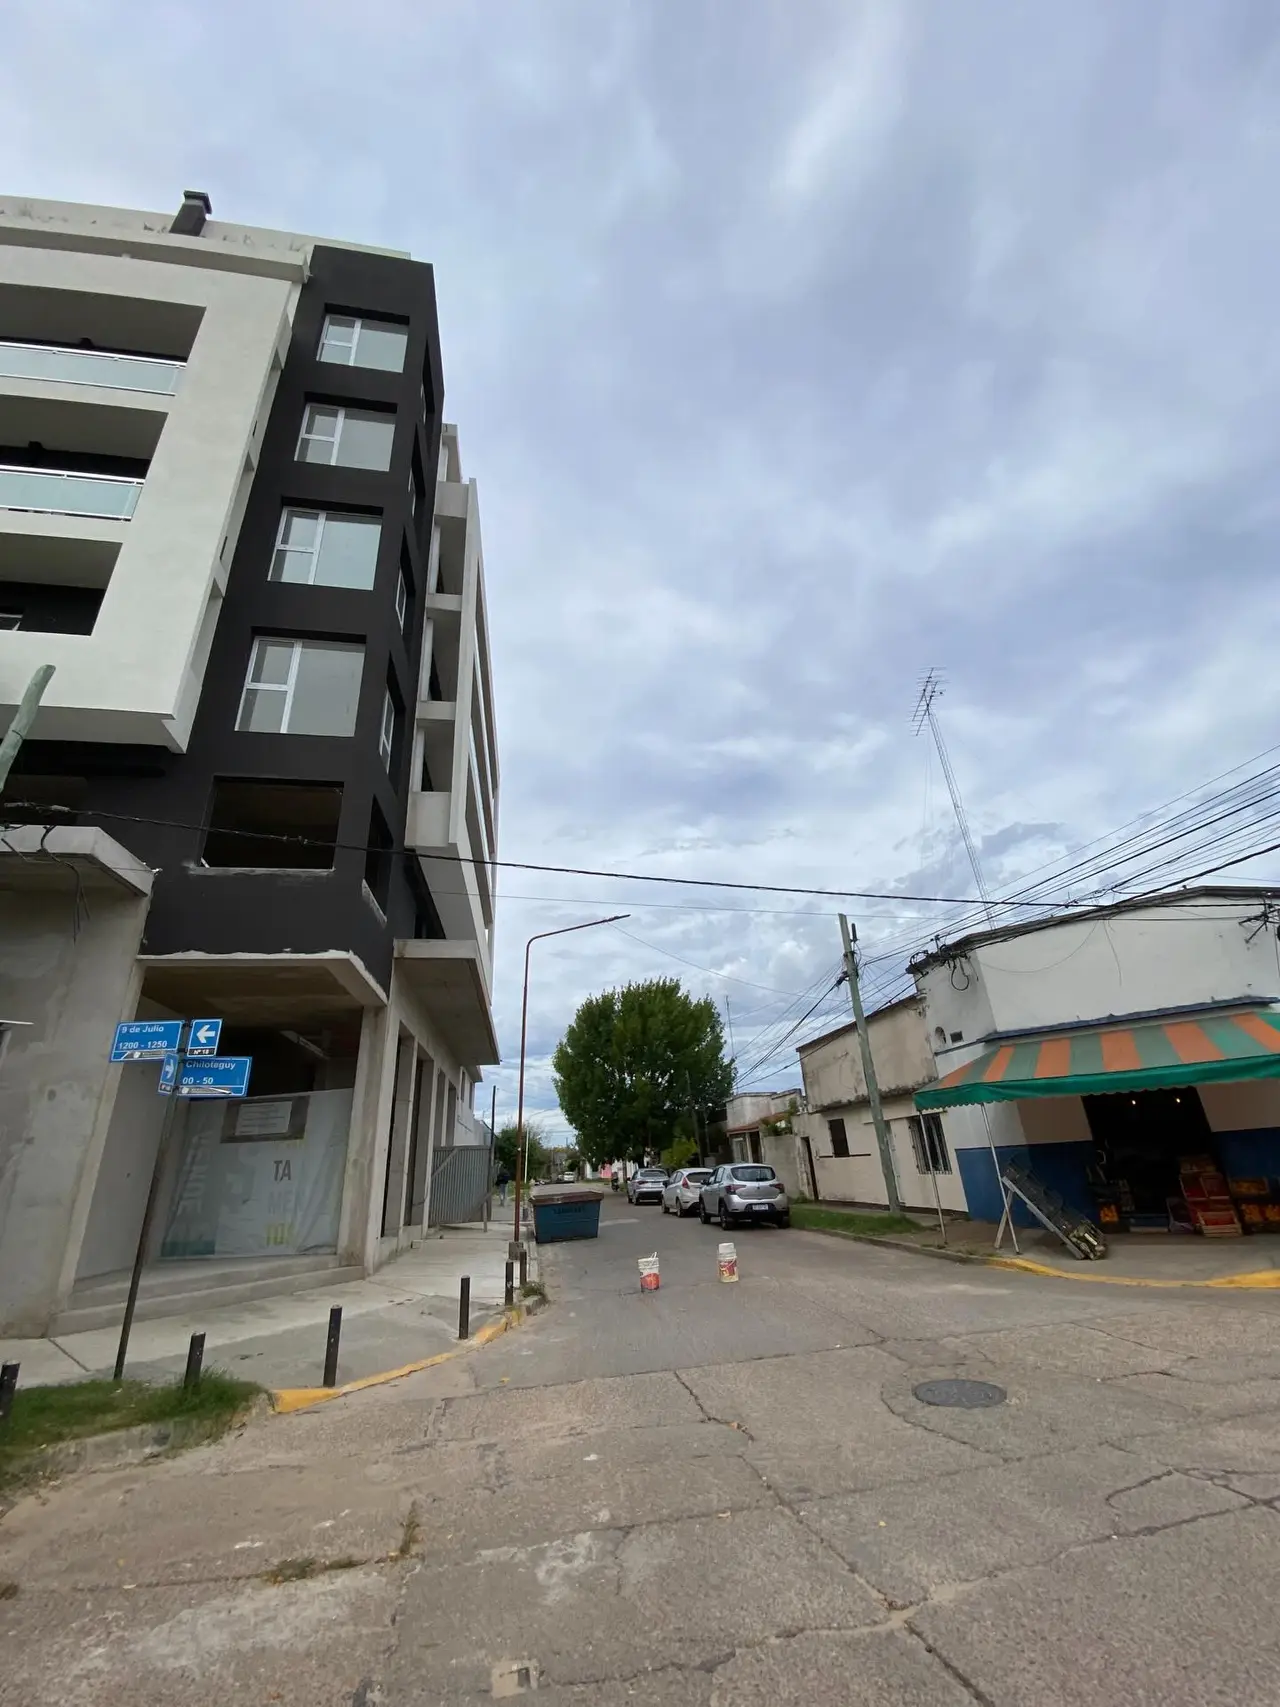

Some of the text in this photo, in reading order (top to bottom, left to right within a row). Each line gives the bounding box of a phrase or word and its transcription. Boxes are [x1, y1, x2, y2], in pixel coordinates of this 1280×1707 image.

[121, 1026, 127, 1034] 9
[142, 1024, 165, 1033] Julio
[119, 1041, 139, 1050] 1200
[147, 1040, 168, 1049] 1250
[182, 1076, 194, 1085] 00
[202, 1076, 214, 1085] 50
[273, 1159, 292, 1182] TA
